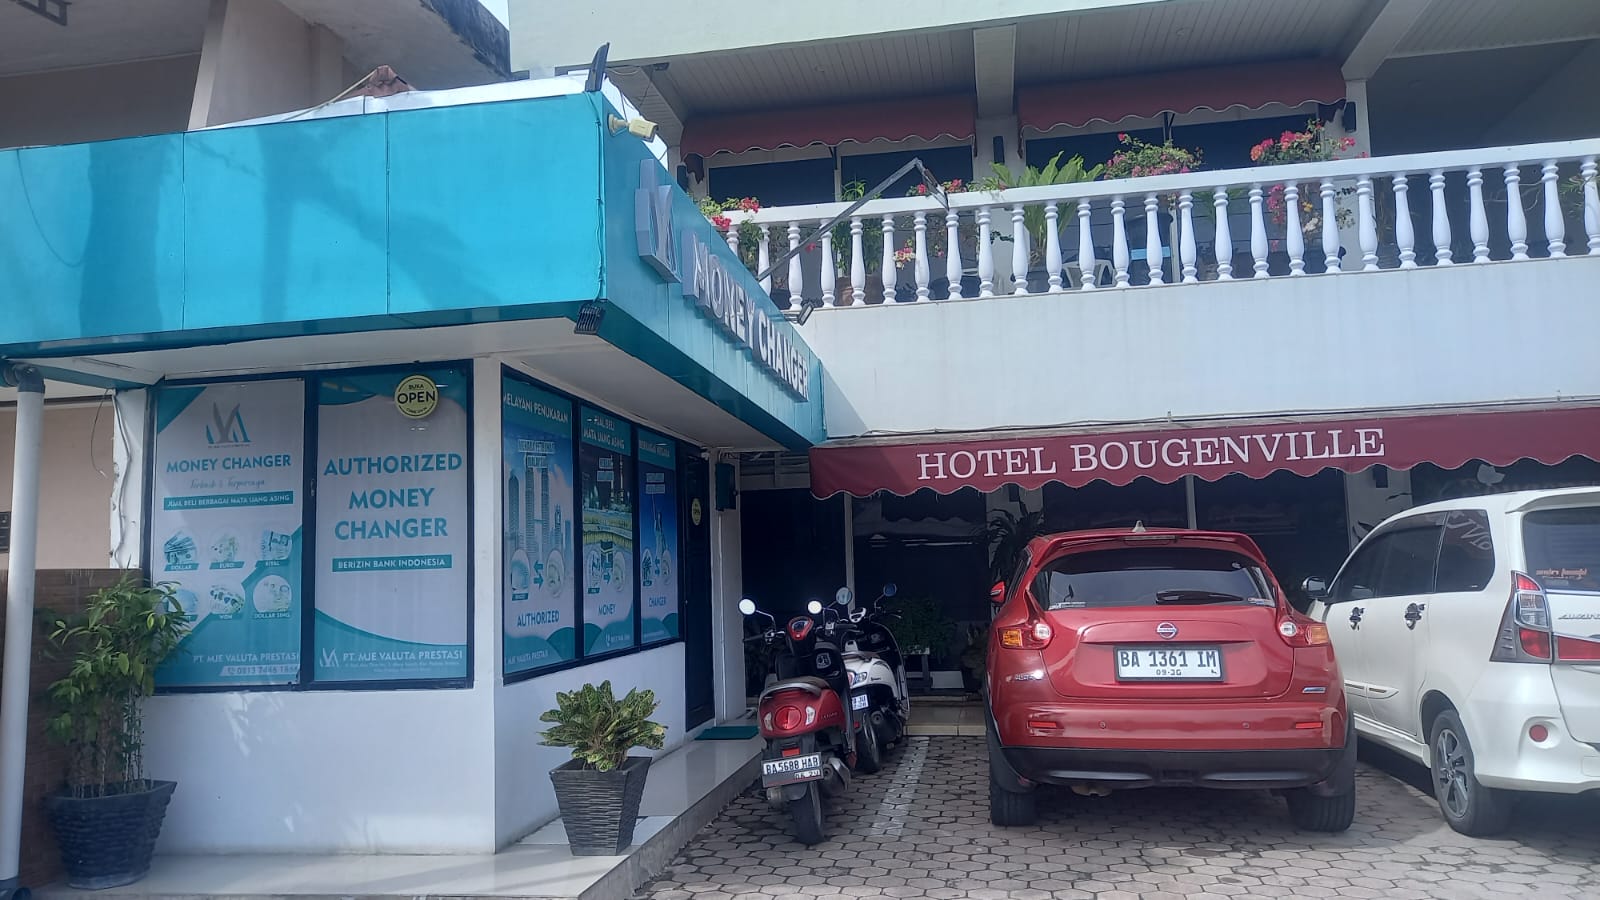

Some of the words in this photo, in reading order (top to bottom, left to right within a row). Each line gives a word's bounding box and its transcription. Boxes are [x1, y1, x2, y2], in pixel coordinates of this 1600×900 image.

[683, 228, 755, 348] MONEY
[756, 309, 809, 400] CHANGER
[397, 391, 436, 404] OPEN
[534, 402, 569, 423] PENUKARAN
[583, 426, 597, 441] MATA
[916, 447, 1057, 480] HOTEL
[1070, 428, 1385, 472] BOUGENVILLE
[166, 458, 218, 473] MONEY
[222, 454, 291, 470] CHANGER
[323, 453, 462, 476] AUTHORIZED
[249, 495, 268, 503] UANG
[269, 494, 290, 502] ASING
[348, 487, 435, 510] MONEY
[334, 517, 448, 541] CHANGER
[338, 560, 371, 569] BERIZIN
[373, 559, 397, 568] BANK
[398, 557, 446, 567] INDONESIA
[598, 603, 616, 616] MONEY
[517, 610, 560, 627] AUTHORIZED
[225, 653, 258, 662] VALUTA
[260, 652, 299, 661] PRESTASI
[380, 650, 416, 661] VALUTA
[418, 650, 463, 660] PRESTASI
[1120, 651, 1140, 668] BA
[1148, 651, 1188, 667] 1361
[1197, 651, 1217, 668] IM
[766, 764, 778, 775] BA
